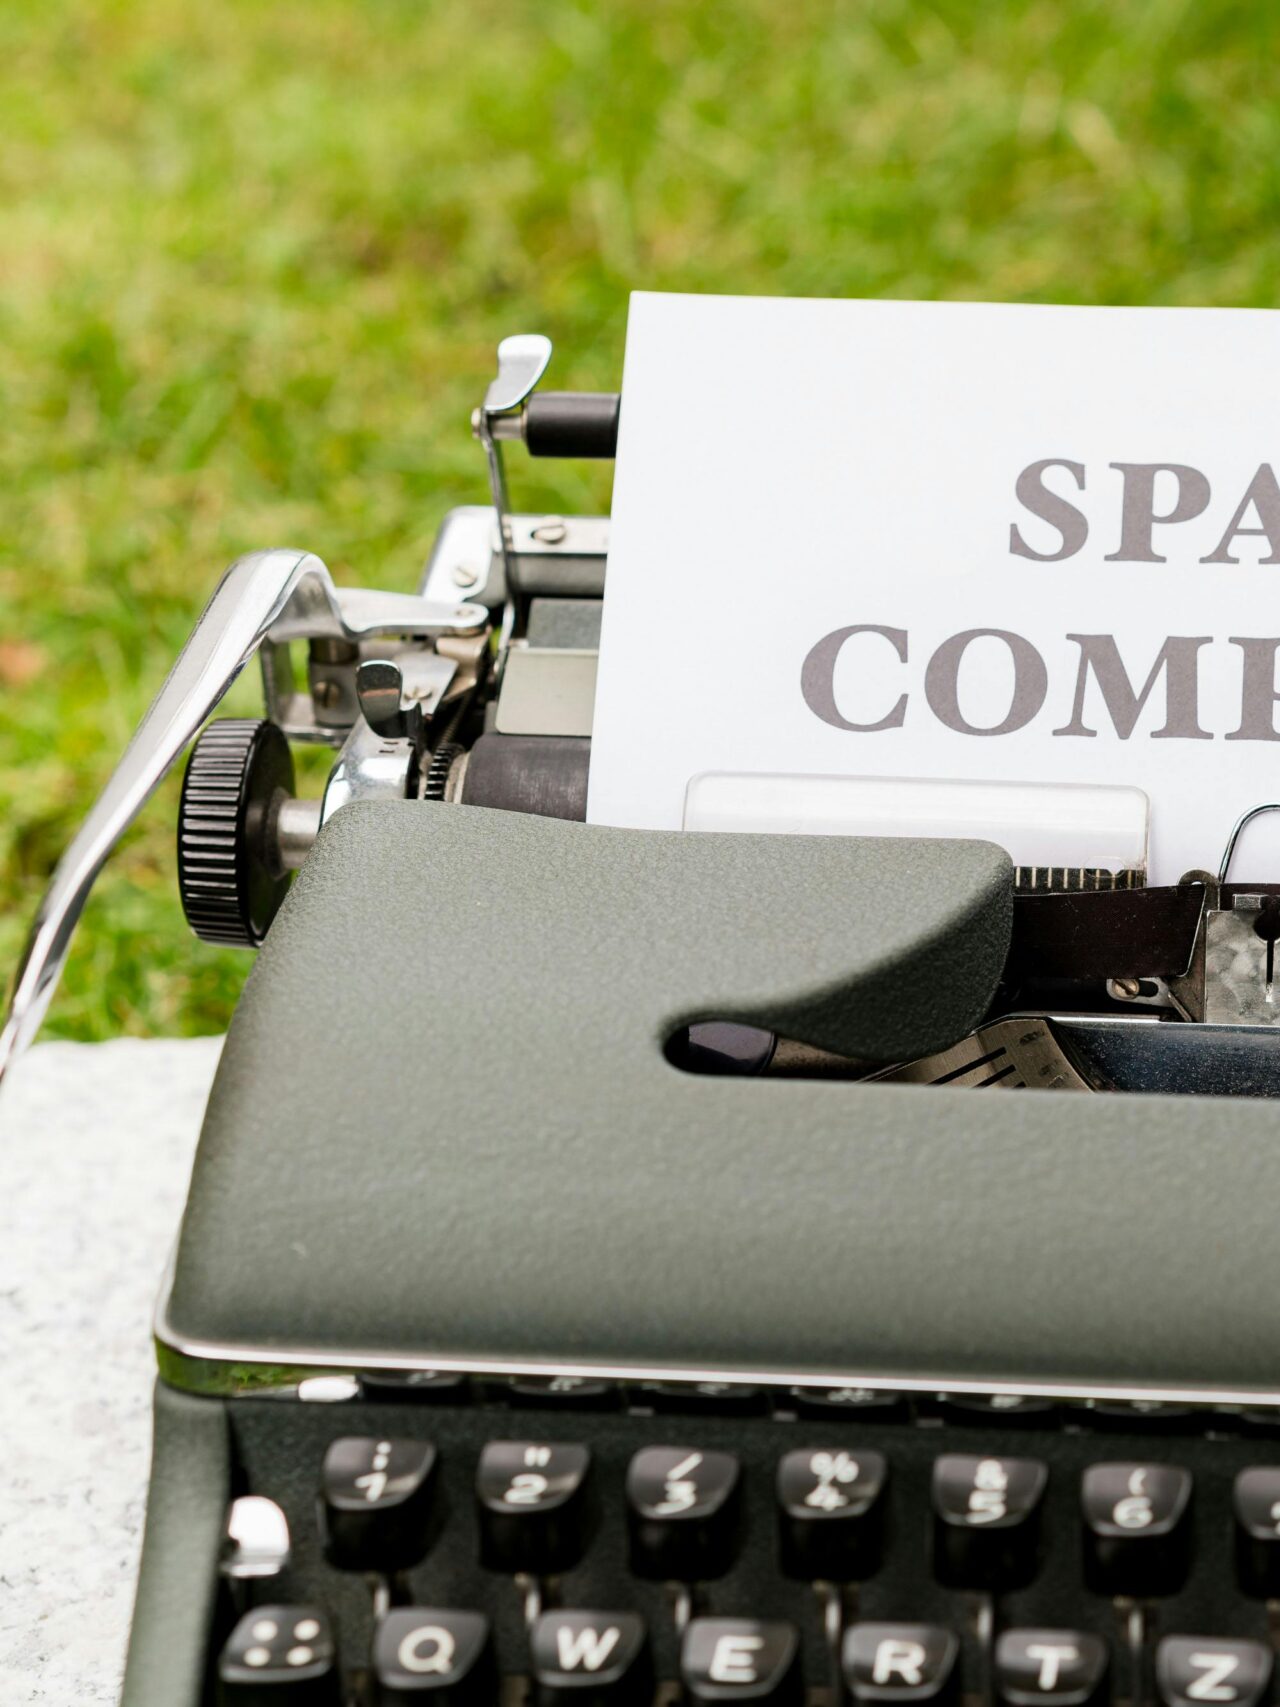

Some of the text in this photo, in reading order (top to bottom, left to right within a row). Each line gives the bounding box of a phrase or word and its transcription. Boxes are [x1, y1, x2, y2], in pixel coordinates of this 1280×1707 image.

[354, 1471, 387, 1502] 1
[504, 1473, 549, 1504] 2
[654, 1479, 697, 1516] 3
[965, 1489, 1007, 1524] 5
[1112, 1496, 1153, 1528] 6
[399, 1625, 455, 1674] Q
[556, 1626, 620, 1671] W
[708, 1634, 764, 1682] E
[872, 1638, 927, 1685] R
[1026, 1644, 1077, 1690] T
[1188, 1652, 1239, 1700] Z
